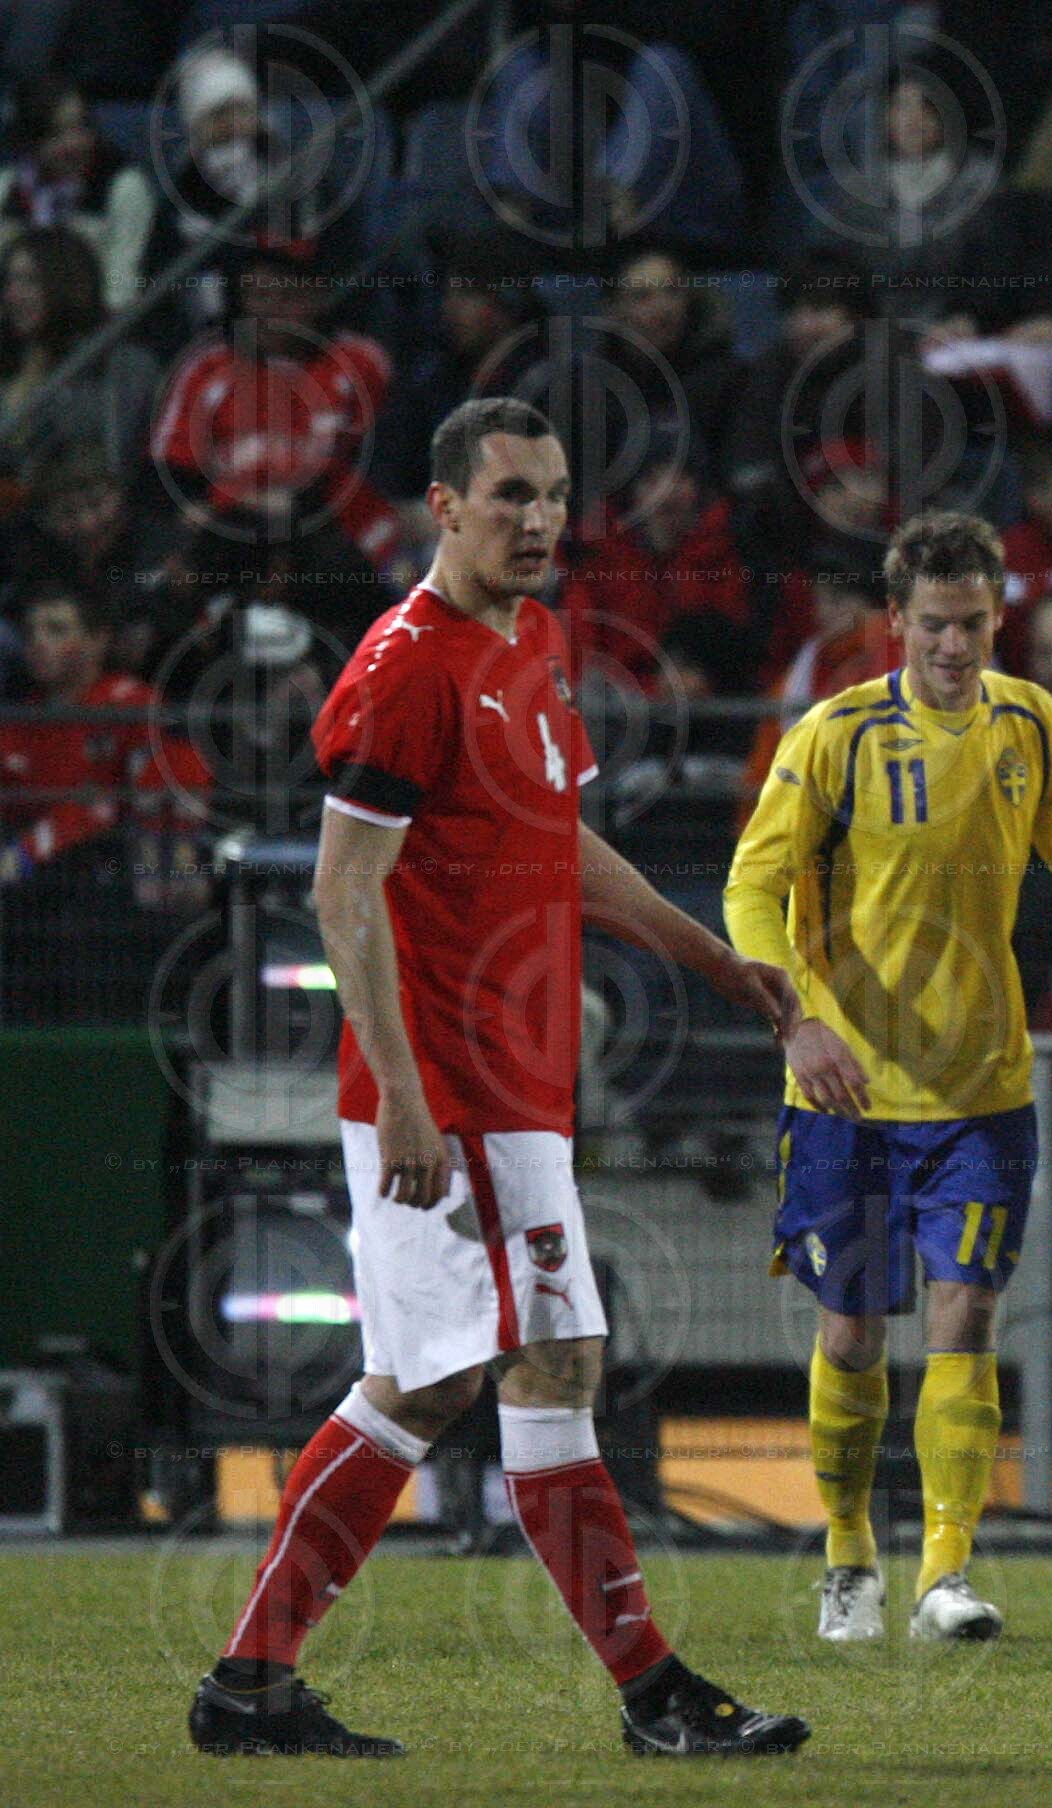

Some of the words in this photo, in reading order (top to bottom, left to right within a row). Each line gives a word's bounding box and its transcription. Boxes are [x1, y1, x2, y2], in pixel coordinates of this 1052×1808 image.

[537, 711, 567, 792] 4
[885, 758, 928, 824] 11
[956, 1201, 1008, 1270] 11
